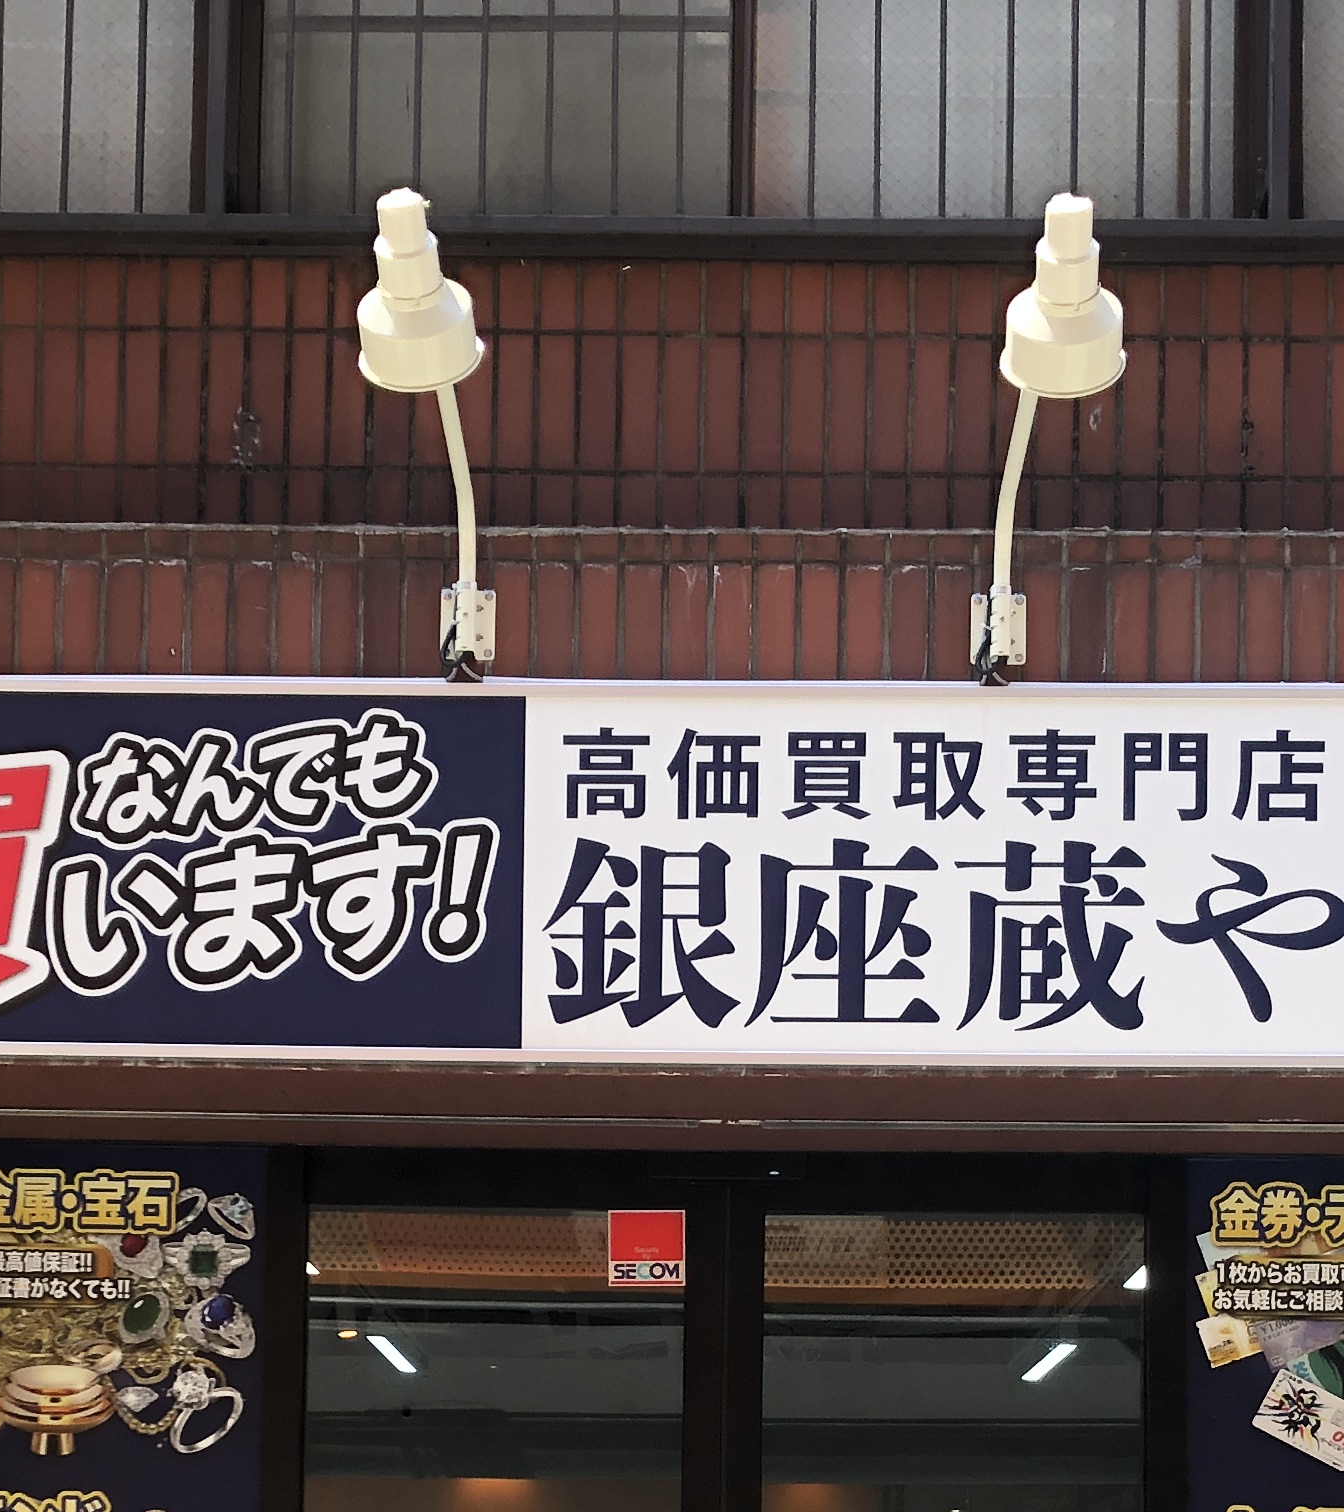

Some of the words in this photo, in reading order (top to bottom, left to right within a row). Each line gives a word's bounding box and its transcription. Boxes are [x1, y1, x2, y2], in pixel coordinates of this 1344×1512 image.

[76, 710, 432, 846] なんでも
[562, 728, 1327, 822] 高価買取専門店
[613, 1262, 680, 1281] SECOM
